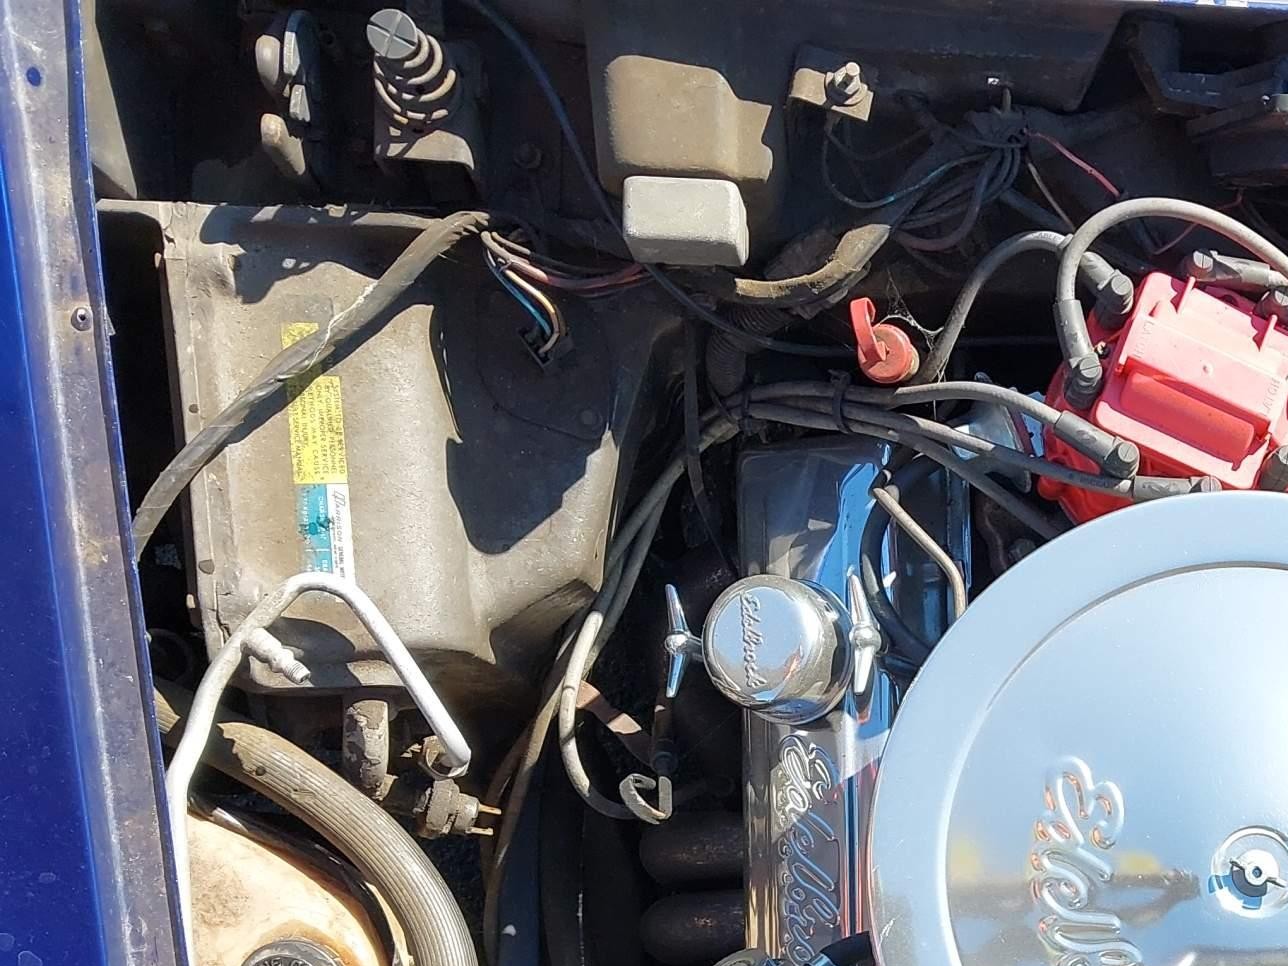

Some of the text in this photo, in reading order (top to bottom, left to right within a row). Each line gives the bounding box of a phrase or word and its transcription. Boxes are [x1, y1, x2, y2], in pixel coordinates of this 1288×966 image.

[318, 409, 326, 441] IMPROPER
[332, 385, 341, 412] SYSTEM
[337, 439, 346, 474] SERVICED
[312, 449, 320, 475] CAUSE
[320, 444, 329, 474] SERVICE
[329, 437, 337, 474] PERSONNEL
[740, 593, 768, 688] Edelbrock
